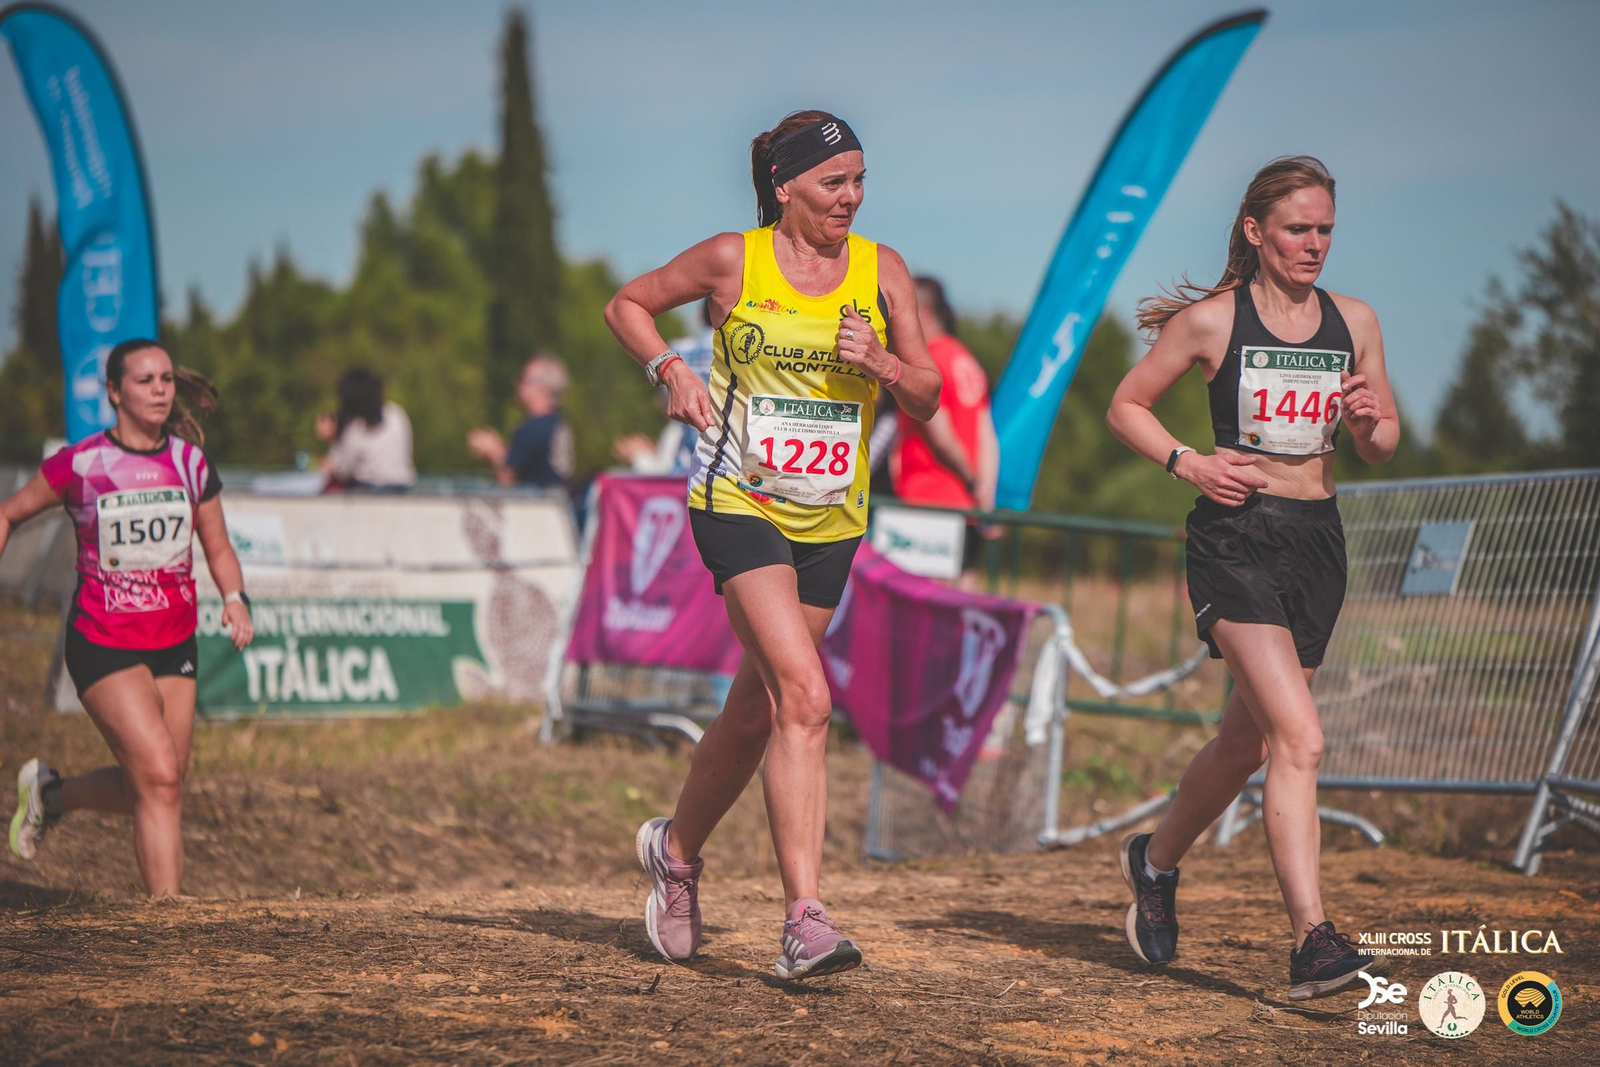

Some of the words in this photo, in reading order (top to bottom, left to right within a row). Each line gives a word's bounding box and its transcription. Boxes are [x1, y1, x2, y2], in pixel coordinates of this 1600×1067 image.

[763, 345, 804, 359] CLUB
[807, 350, 851, 364] ATLE
[1276, 353, 1327, 367] ITÁLICA
[783, 401, 833, 417] ITÁLICA
[1252, 390, 1342, 424] 1446
[758, 437, 850, 476] 1228
[110, 516, 184, 546] 1507
[245, 636, 399, 701] ITÁLICA
